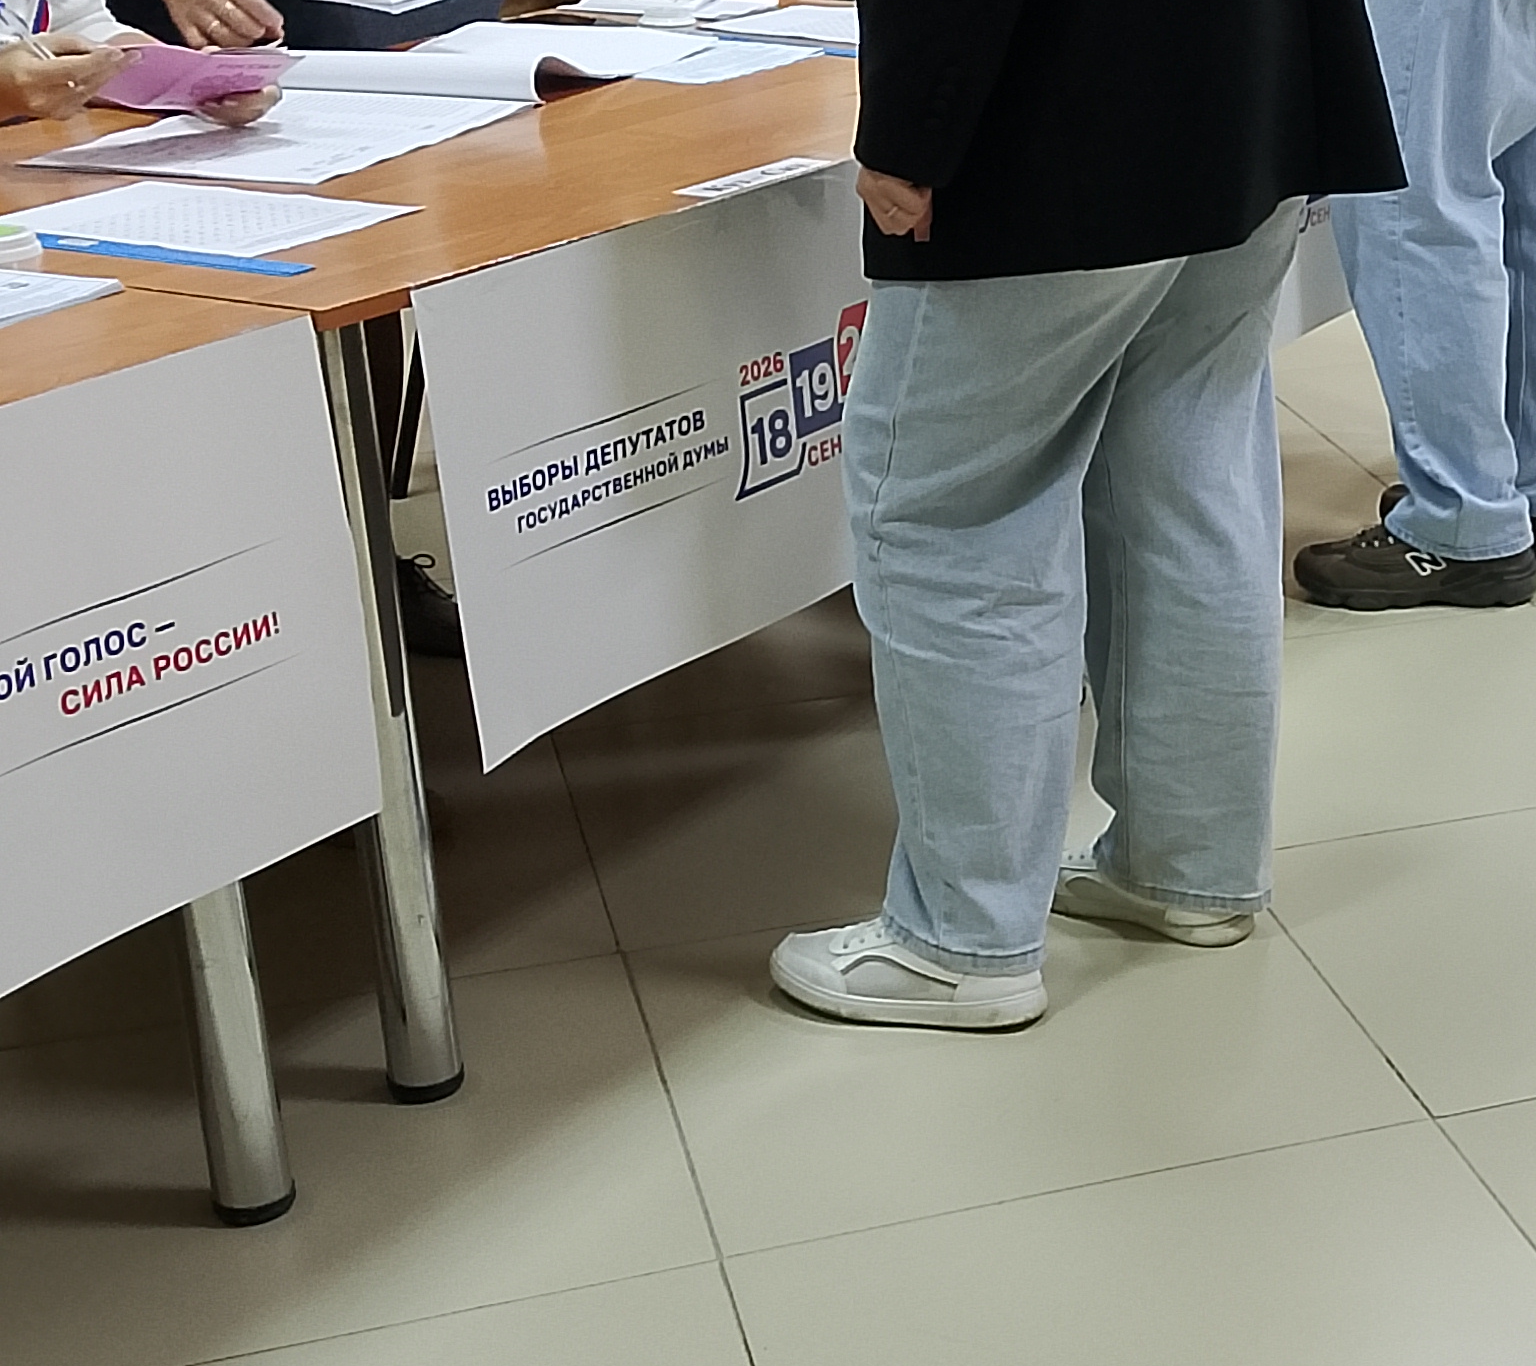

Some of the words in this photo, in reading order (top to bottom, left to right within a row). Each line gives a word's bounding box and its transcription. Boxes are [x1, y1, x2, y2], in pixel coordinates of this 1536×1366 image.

[739, 351, 784, 387] 2026
[751, 408, 793, 466] 18
[795, 361, 836, 419] 19
[487, 454, 578, 512] ВЫБОРЫ
[585, 409, 705, 472] ДЕПУТАТОВ
[517, 457, 679, 533] ГОСУДАРСТВЕННОЙ
[682, 435, 729, 470] ДУМЫ
[43, 621, 148, 681] ГОЛОС
[60, 664, 147, 716] СИЛА
[152, 610, 281, 681] РОССИИ!
